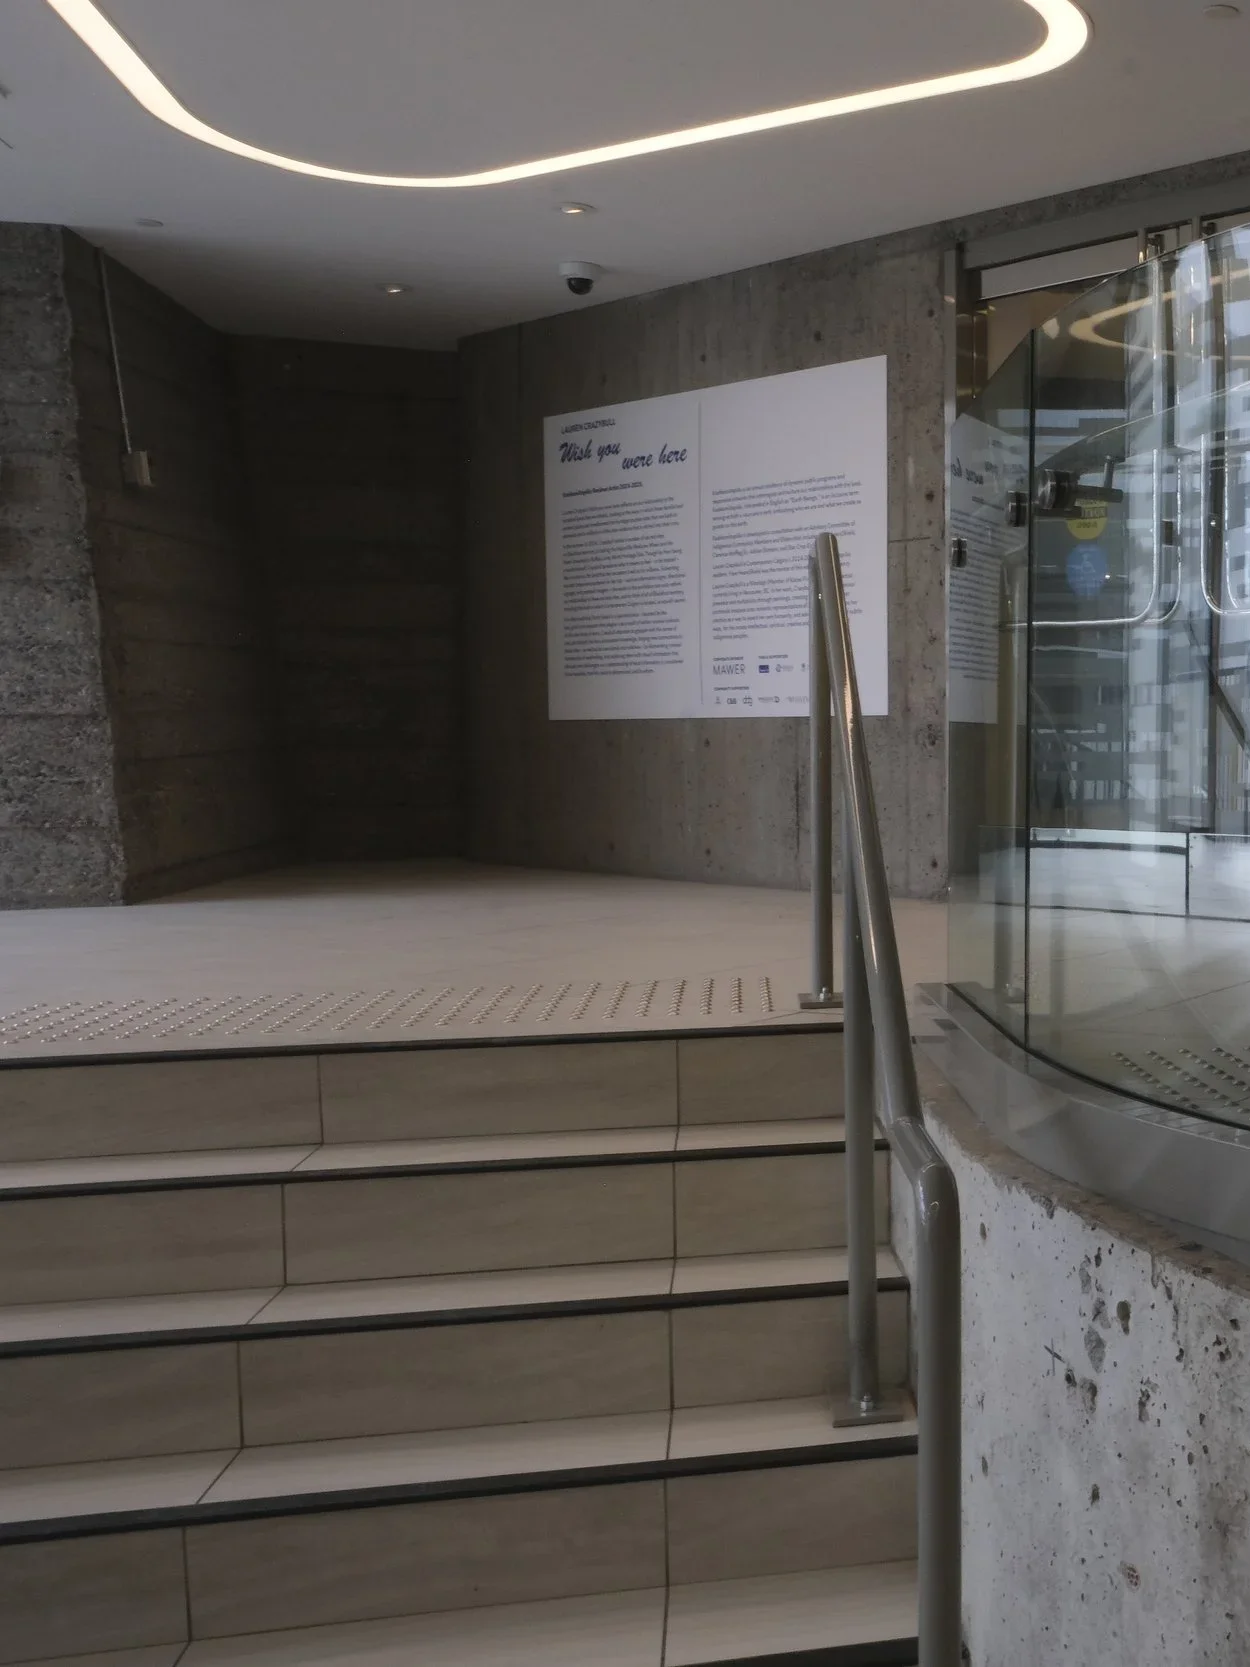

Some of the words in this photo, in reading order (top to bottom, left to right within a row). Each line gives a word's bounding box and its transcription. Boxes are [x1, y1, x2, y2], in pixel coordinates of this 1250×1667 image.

[559, 439, 593, 463] Wish
[597, 443, 621, 463] you
[621, 454, 654, 470] were
[658, 444, 688, 464] here
[712, 663, 746, 675] MAWER
